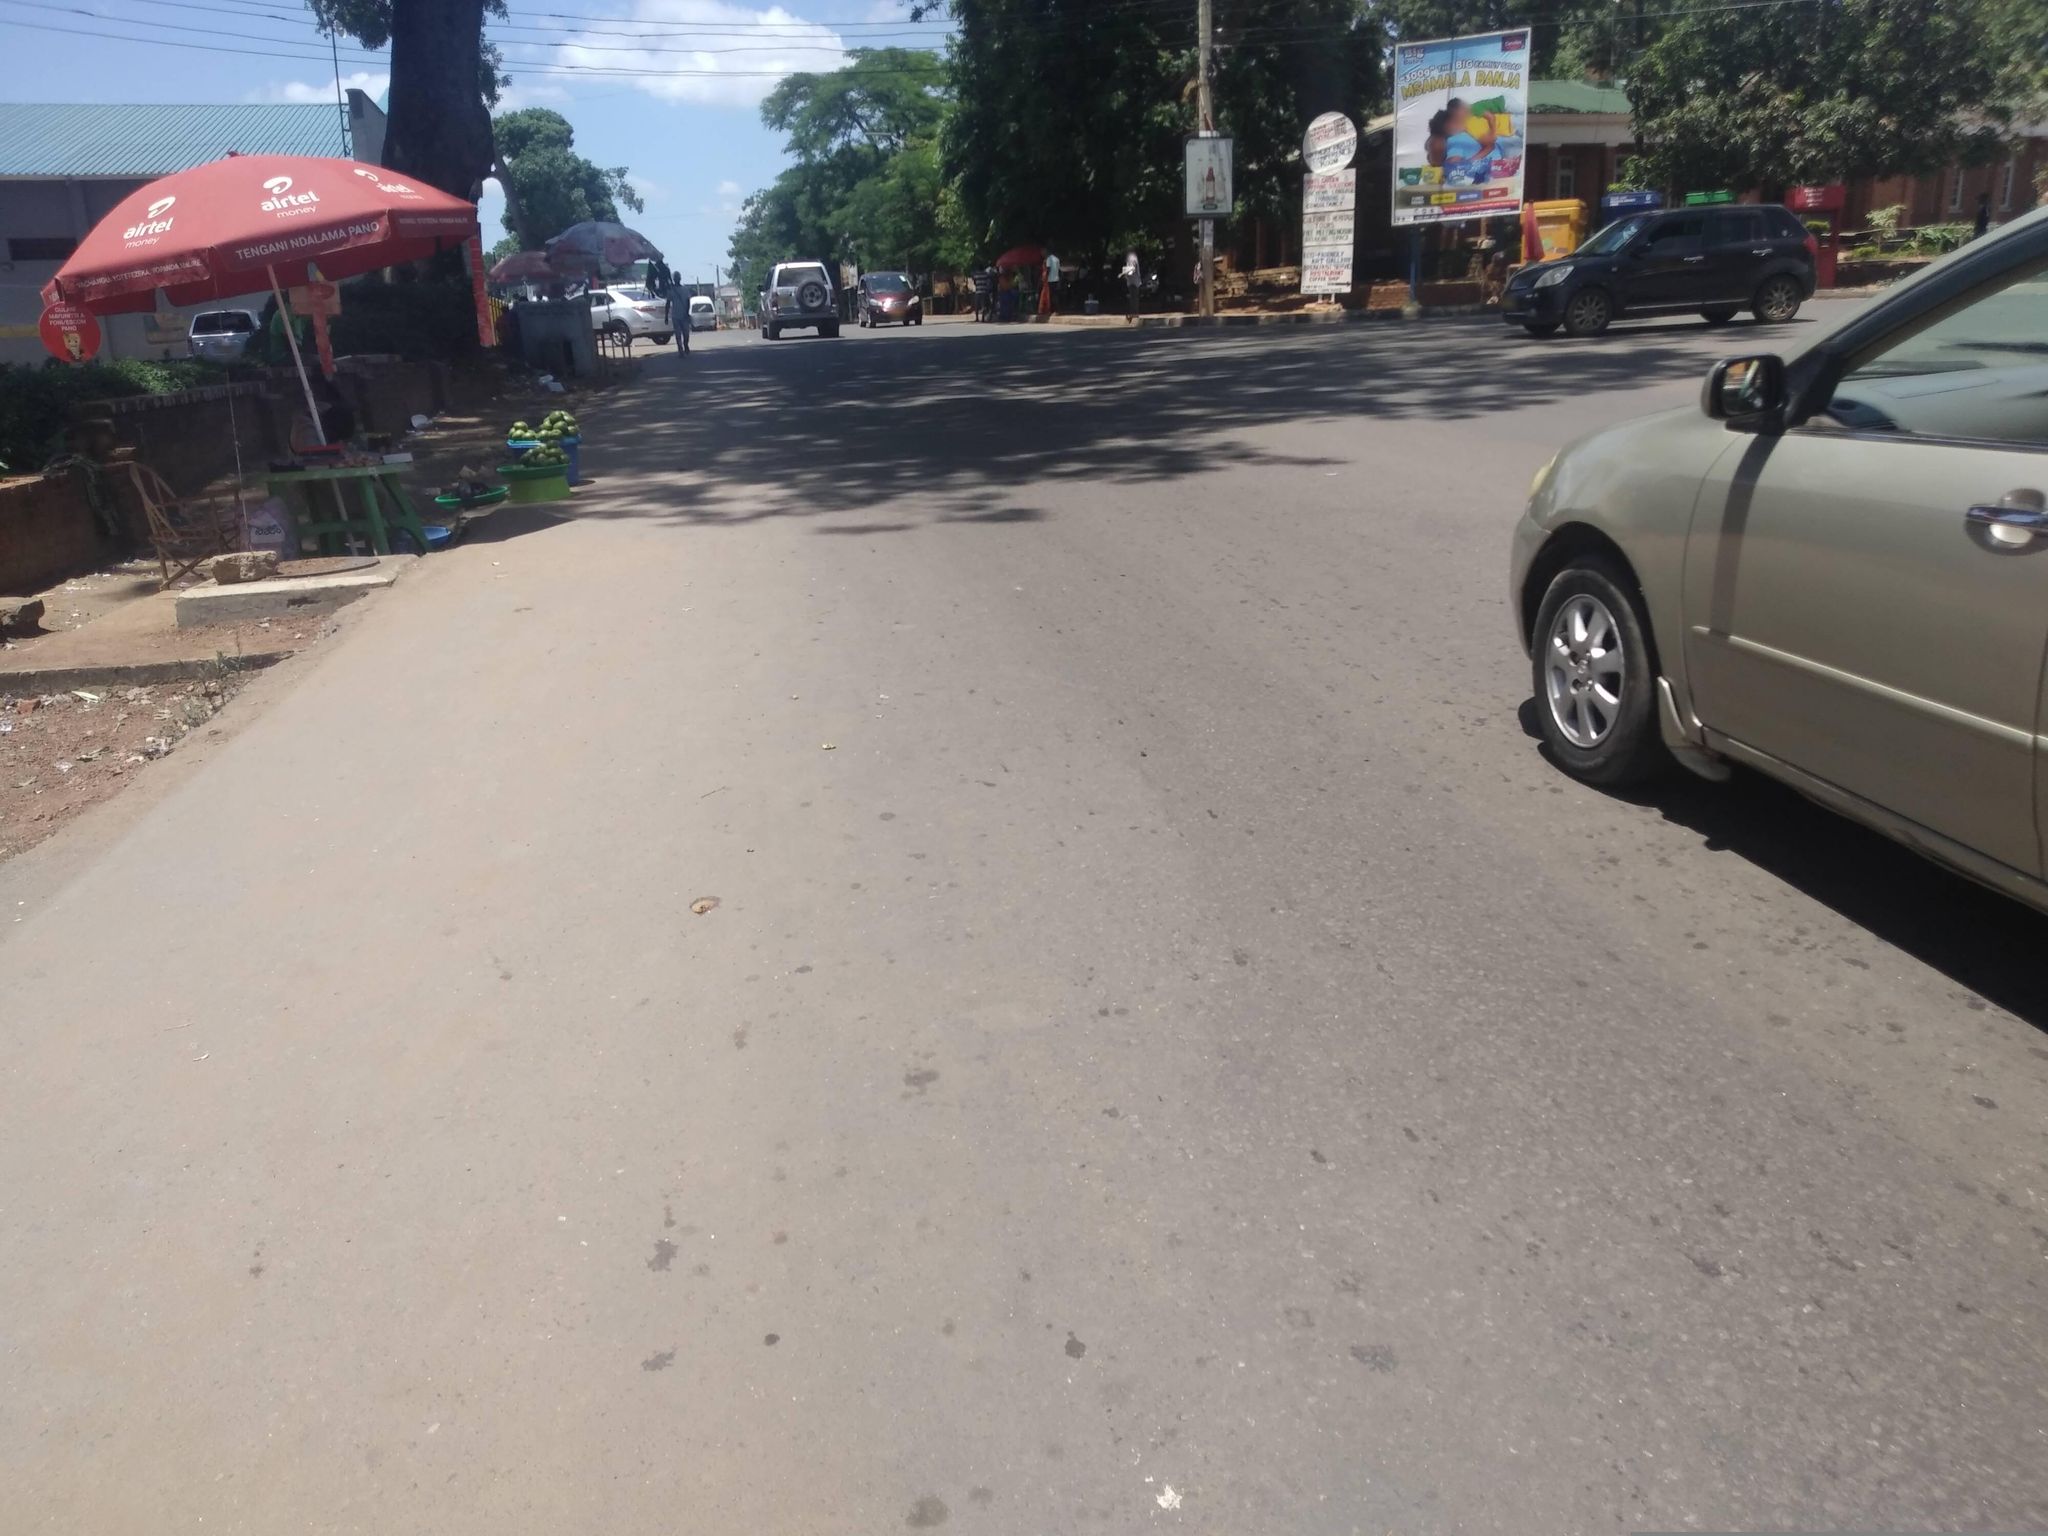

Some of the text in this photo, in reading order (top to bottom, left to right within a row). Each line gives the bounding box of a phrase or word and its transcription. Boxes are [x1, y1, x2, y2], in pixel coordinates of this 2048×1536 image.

[1455, 60, 1473, 70] BIG
[1401, 69, 1521, 100] MSAMALA BANJA
[260, 190, 320, 212] airtel
[276, 205, 317, 218] money
[123, 217, 174, 239] airtel
[125, 236, 160, 249] money
[236, 221, 380, 260] TENGANI NDALAMA PANO
